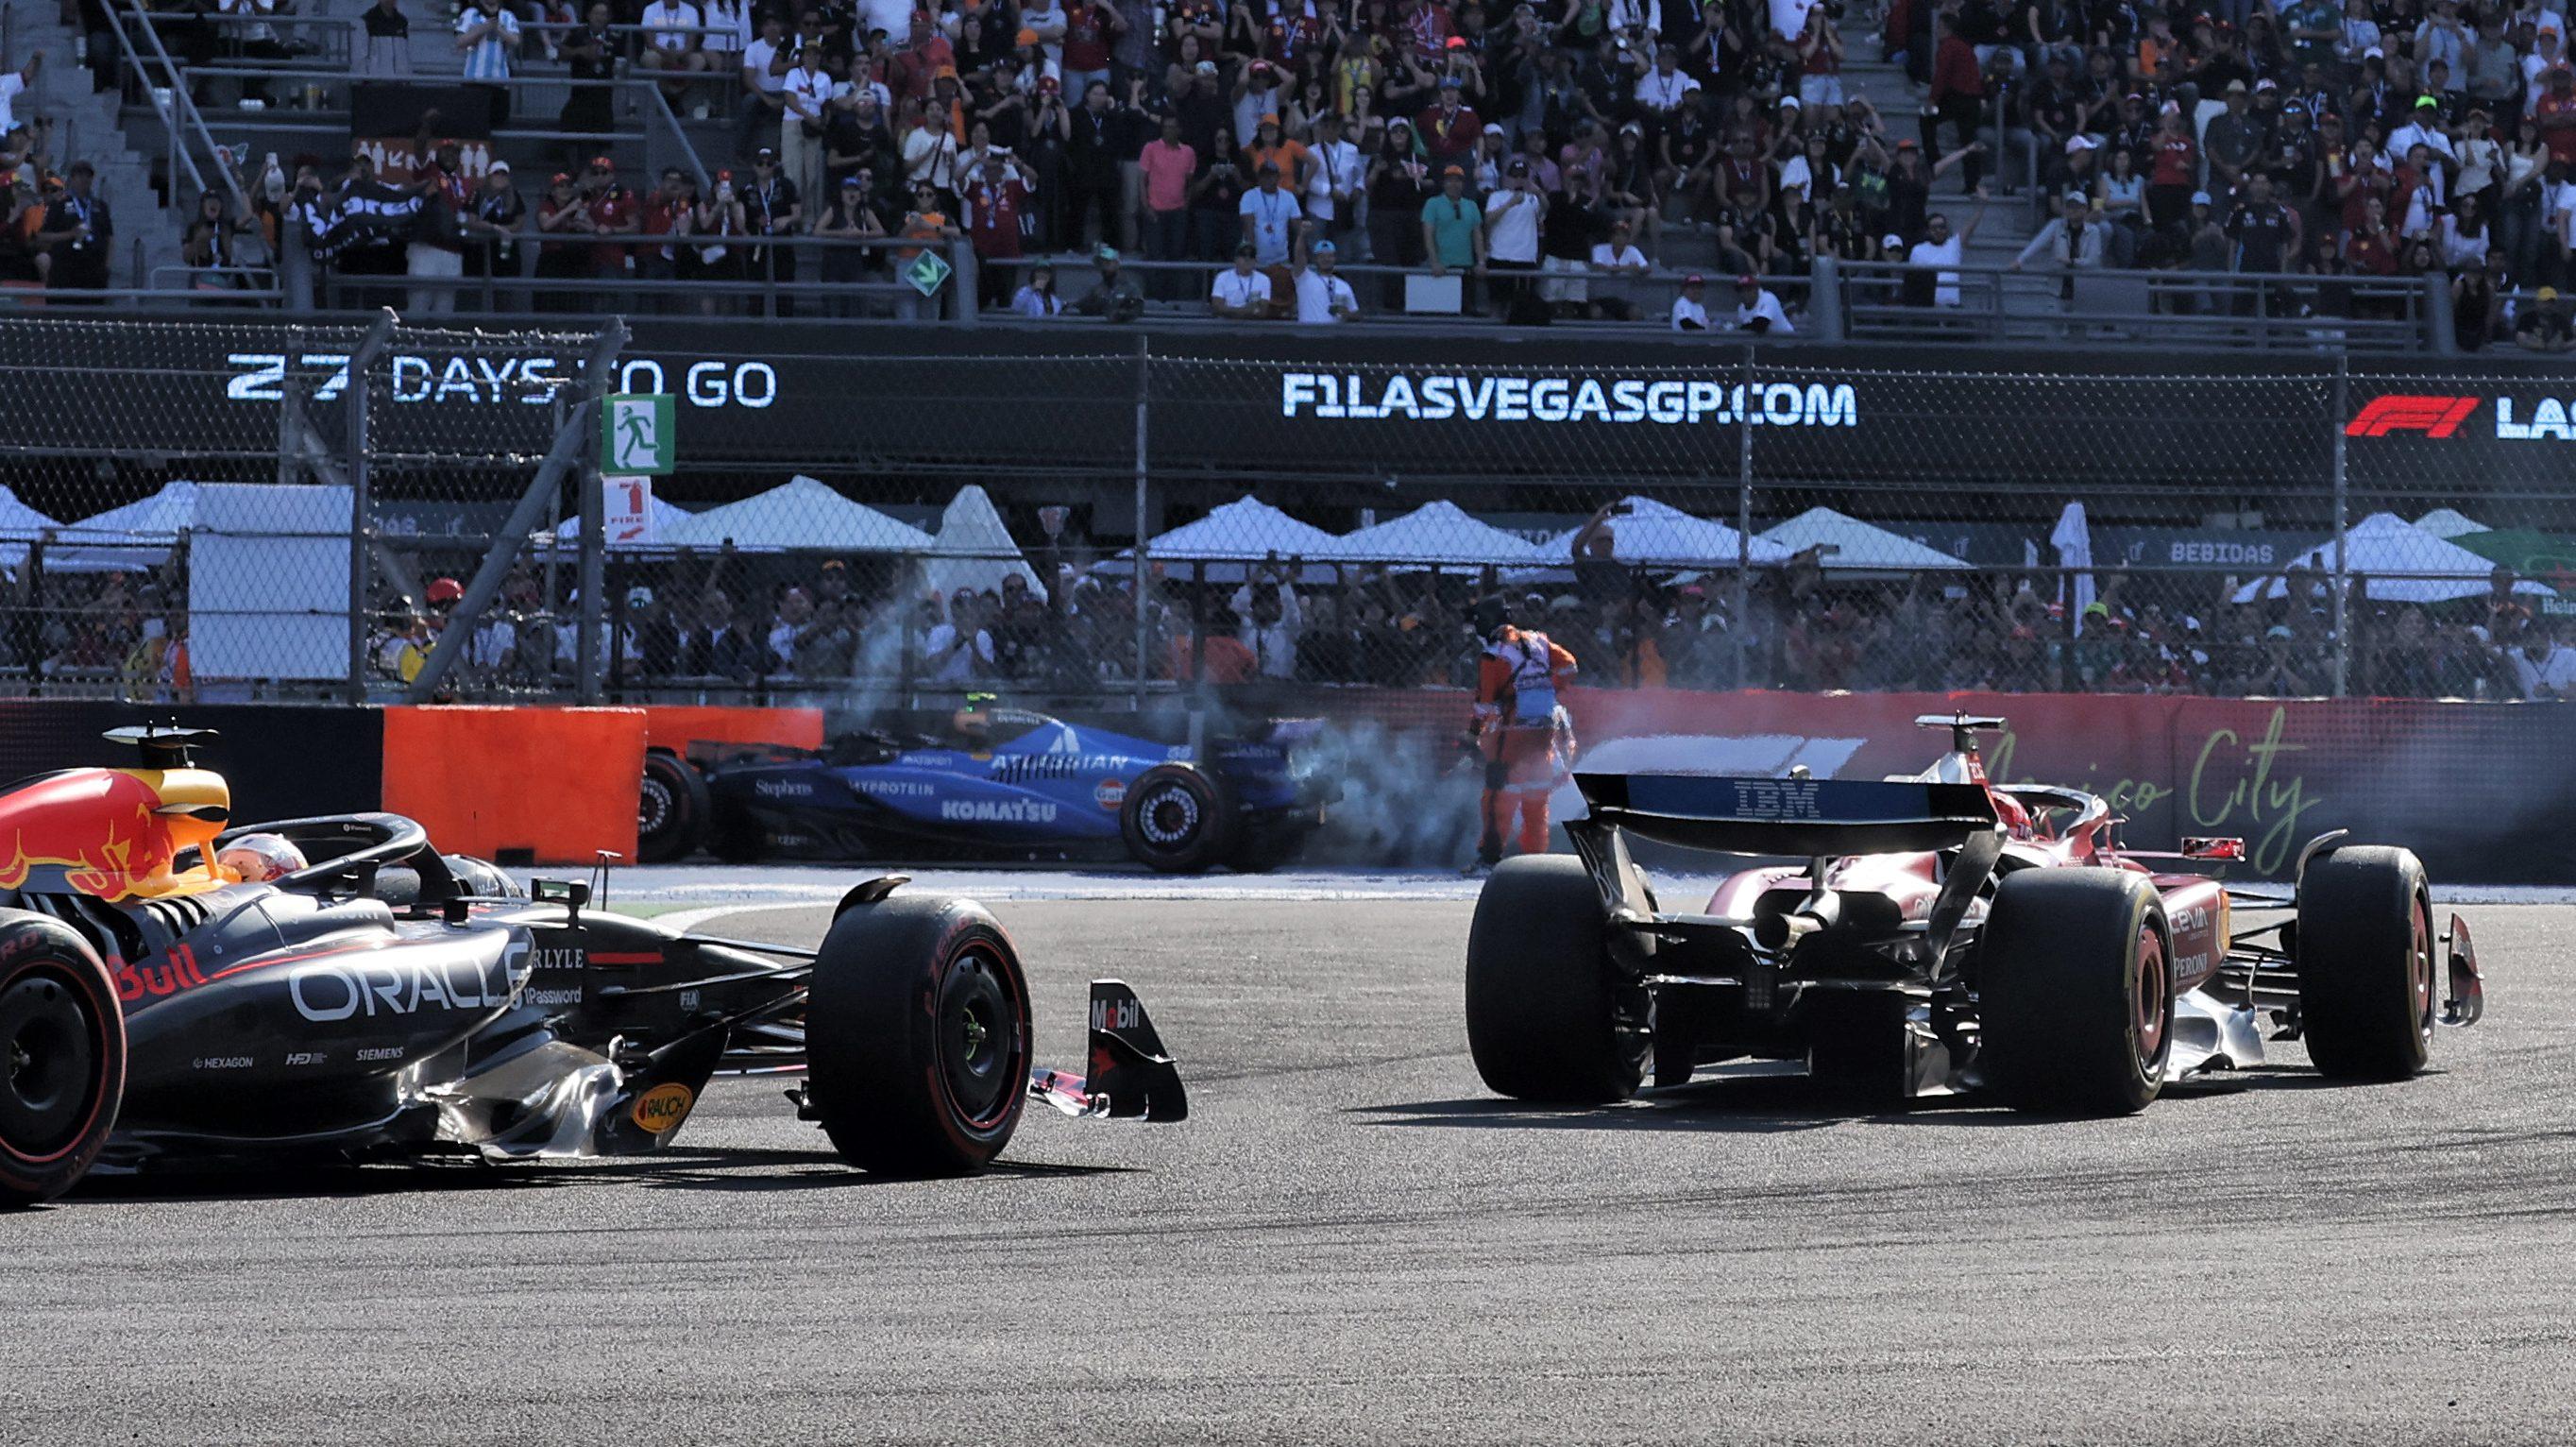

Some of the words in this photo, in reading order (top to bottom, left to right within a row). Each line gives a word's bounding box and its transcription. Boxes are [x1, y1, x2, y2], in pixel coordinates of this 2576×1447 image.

[227, 353, 351, 400] 27
[392, 356, 556, 405] DAYS
[686, 361, 776, 408] GO
[1281, 372, 1858, 428] F1LASVEGASGP.COM
[2496, 396, 2576, 439] LA
[609, 516, 644, 525] FIRE
[2170, 541, 2275, 564] BEBIDAS
[754, 777, 815, 799] Stephens
[848, 778, 935, 797] MYPROTEIN
[1734, 780, 1821, 819] IBM
[2189, 706, 2324, 877] City
[941, 799, 1057, 823] KOMATSU
[533, 948, 584, 969] RLYLE
[2174, 951, 2208, 979] PERONI
[106, 942, 209, 1002] Bull
[288, 941, 531, 1022] ORACLE
[523, 985, 583, 1006] 1Password
[680, 992, 699, 1009] FIA
[1091, 997, 1140, 1030] Mobil
[203, 1056, 254, 1069] HEXAGON
[355, 1046, 404, 1062] SIEMENS
[647, 1095, 686, 1119] RAUCH
